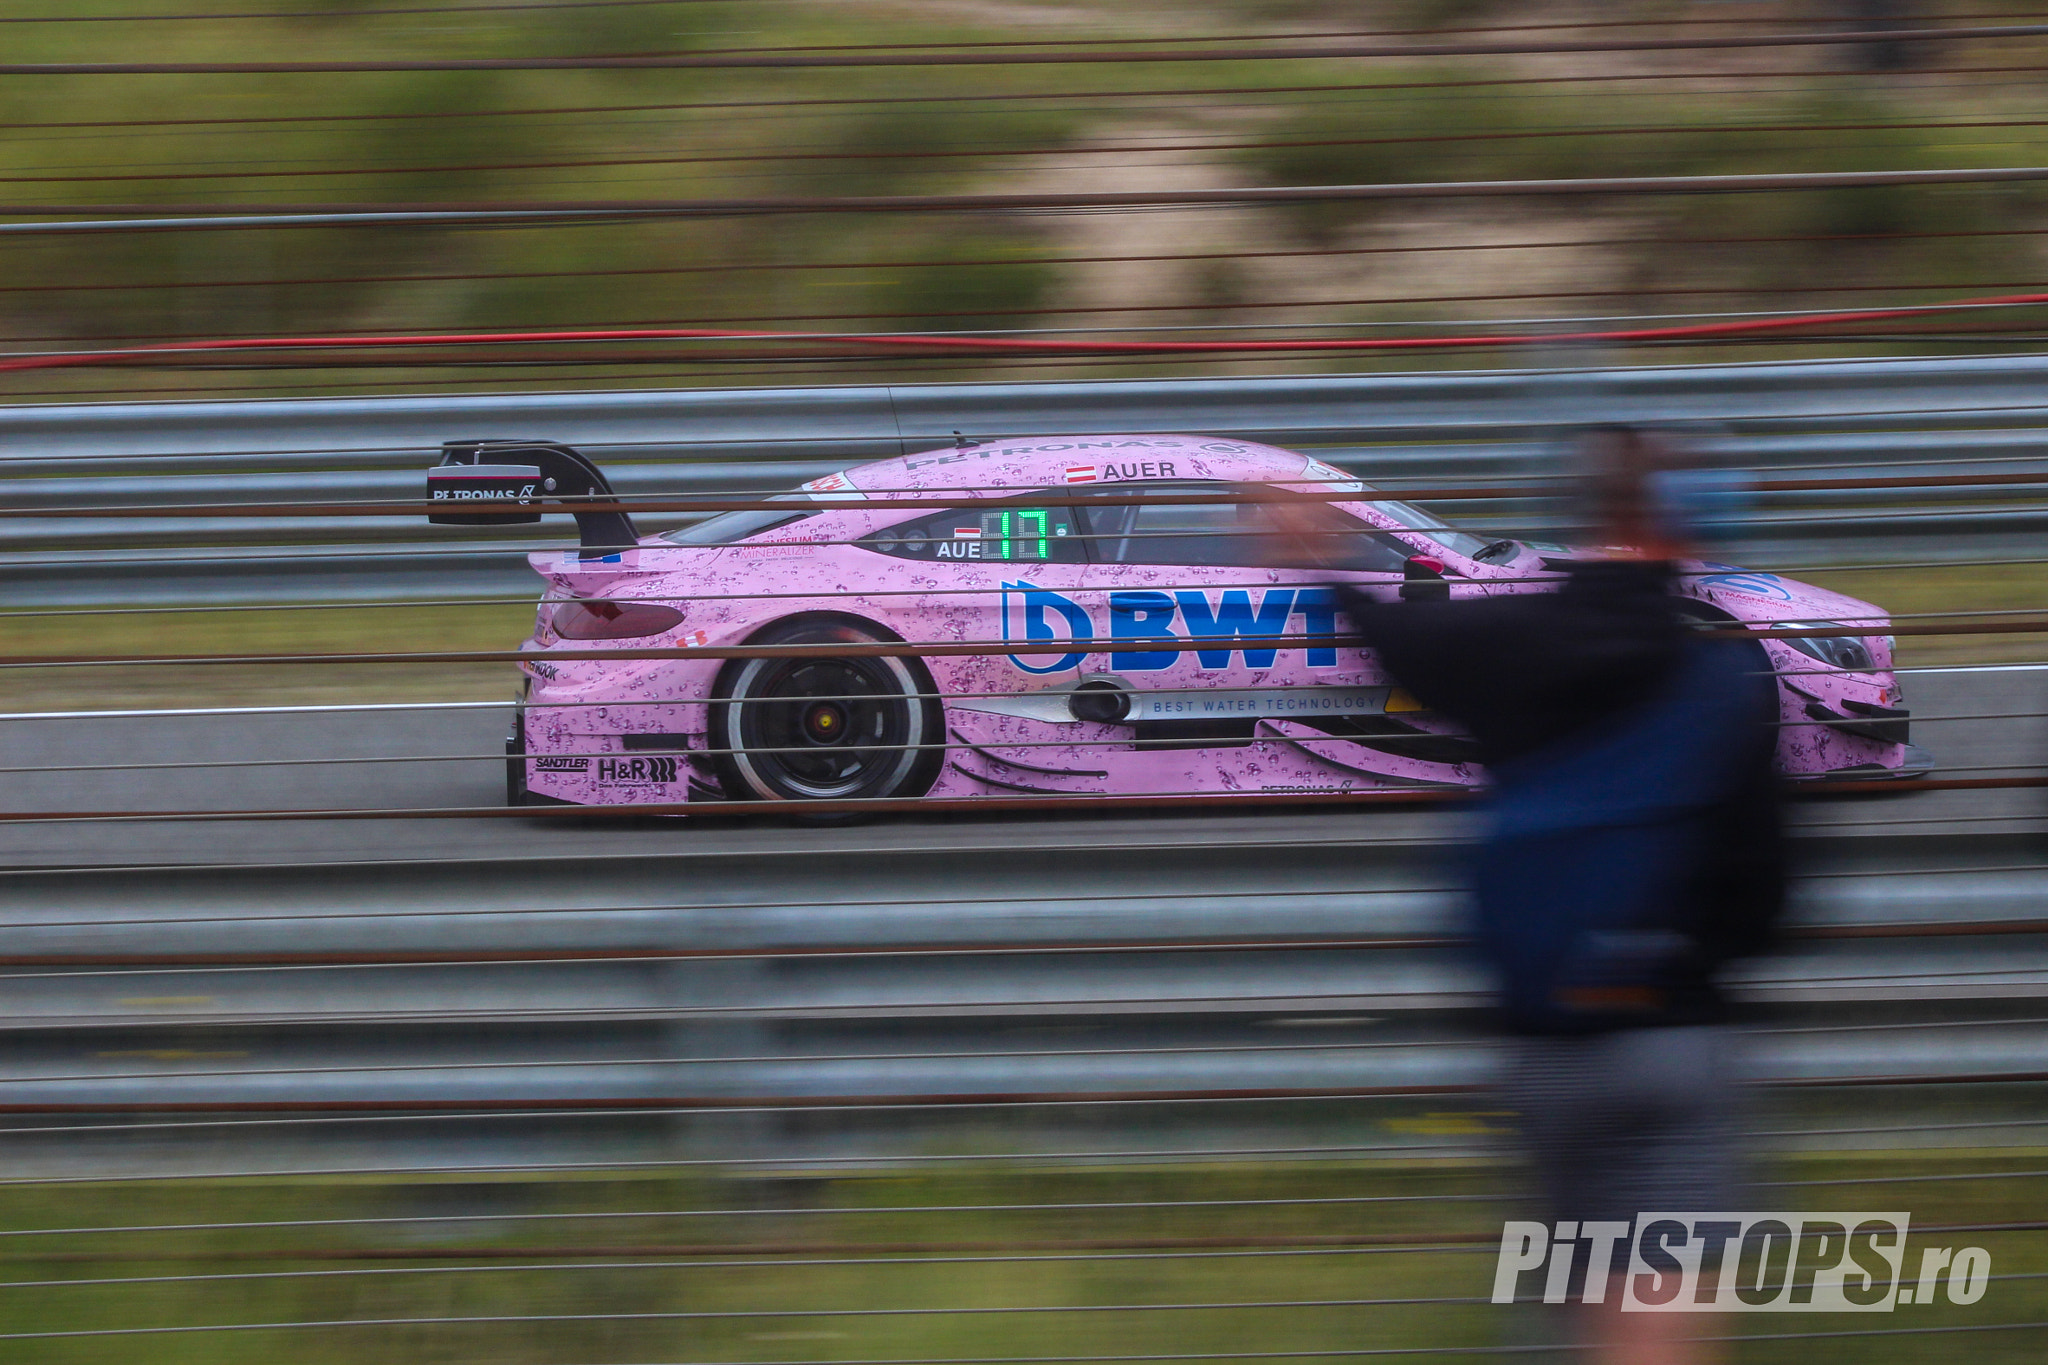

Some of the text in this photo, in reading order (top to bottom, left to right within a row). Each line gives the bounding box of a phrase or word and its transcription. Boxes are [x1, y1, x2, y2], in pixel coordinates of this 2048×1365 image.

[906, 441, 1184, 471] PETRONAS
[1104, 462, 1176, 479] AUER
[433, 490, 515, 500] PETRONAS
[1001, 510, 1048, 560] 17
[740, 547, 815, 559] MINERALIZER
[1154, 697, 1377, 713] BEST WATER TECHNOLOGY
[536, 758, 588, 768] SANDTLER
[599, 758, 650, 783] H&R
